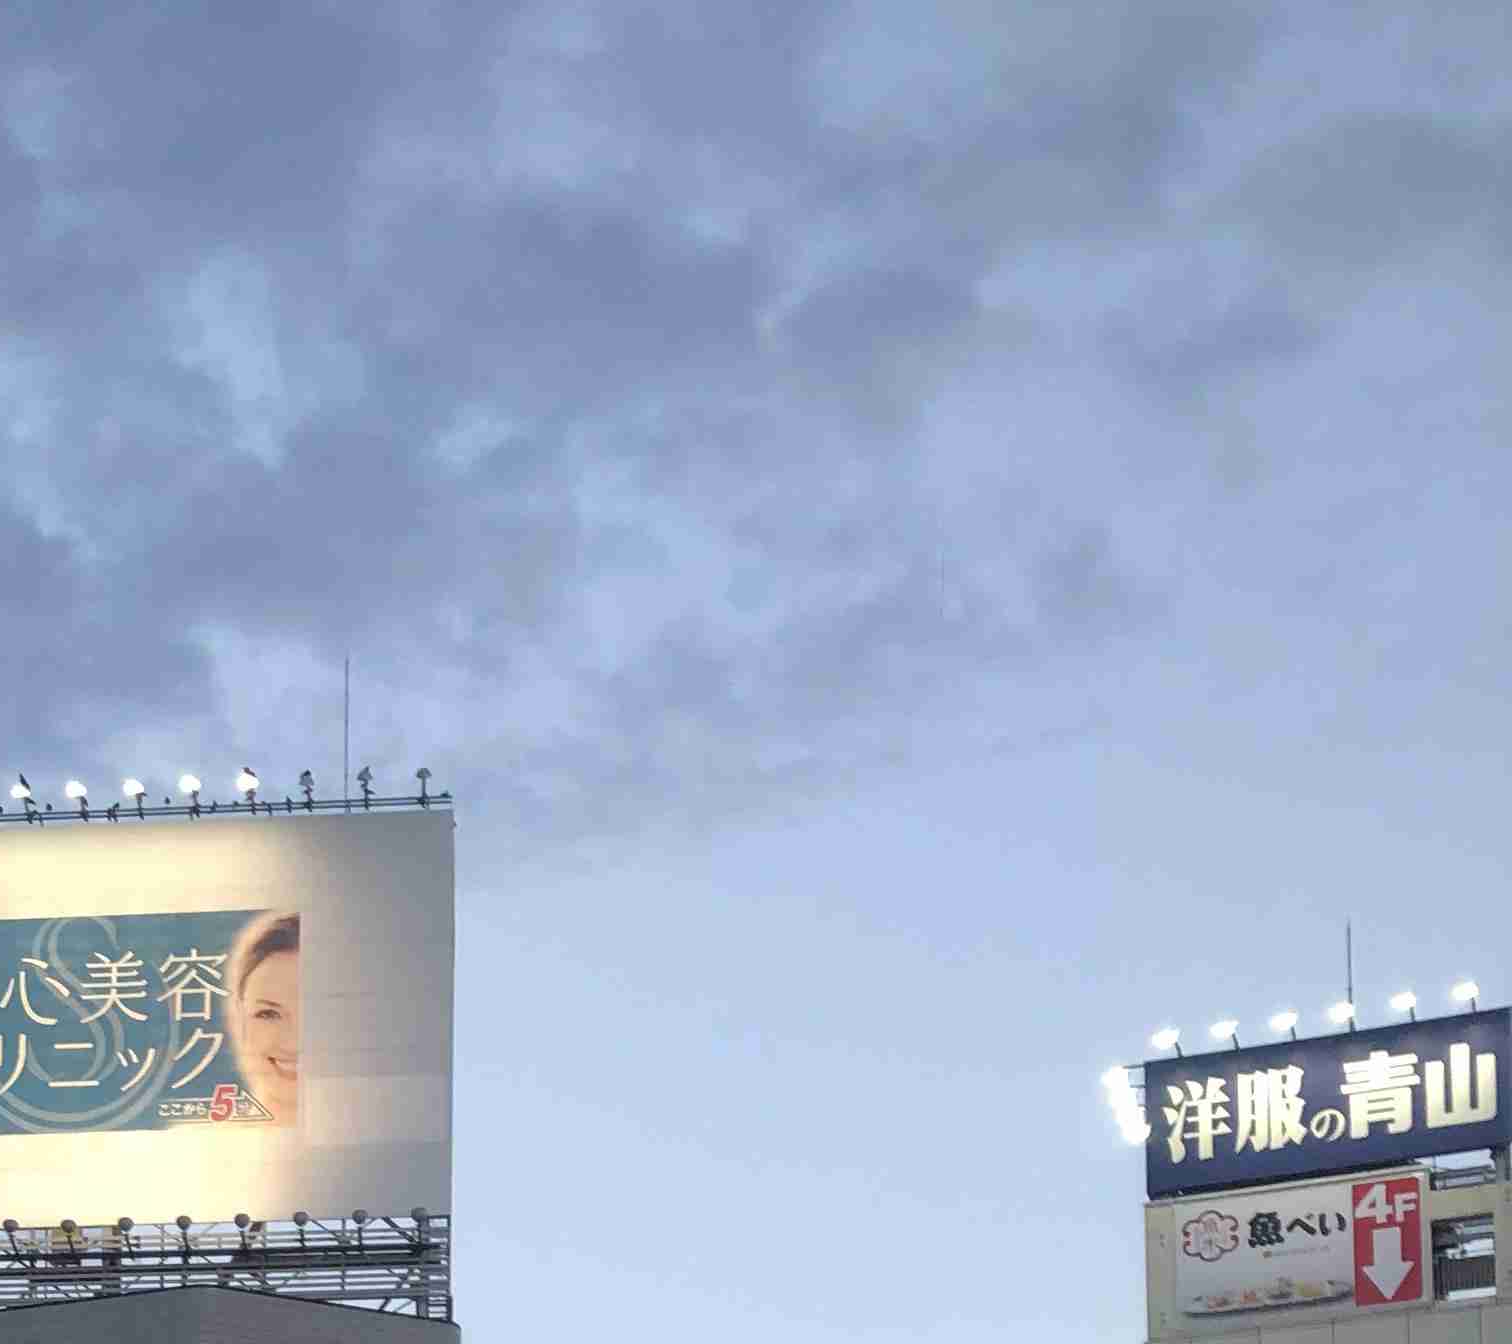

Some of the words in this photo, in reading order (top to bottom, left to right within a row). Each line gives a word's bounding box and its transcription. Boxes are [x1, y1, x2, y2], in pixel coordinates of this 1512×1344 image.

[1163, 1042, 1497, 1164] 洋服の青山
[1354, 1183, 1418, 1224] 4F
[1248, 1211, 1347, 1249] 魚べい
